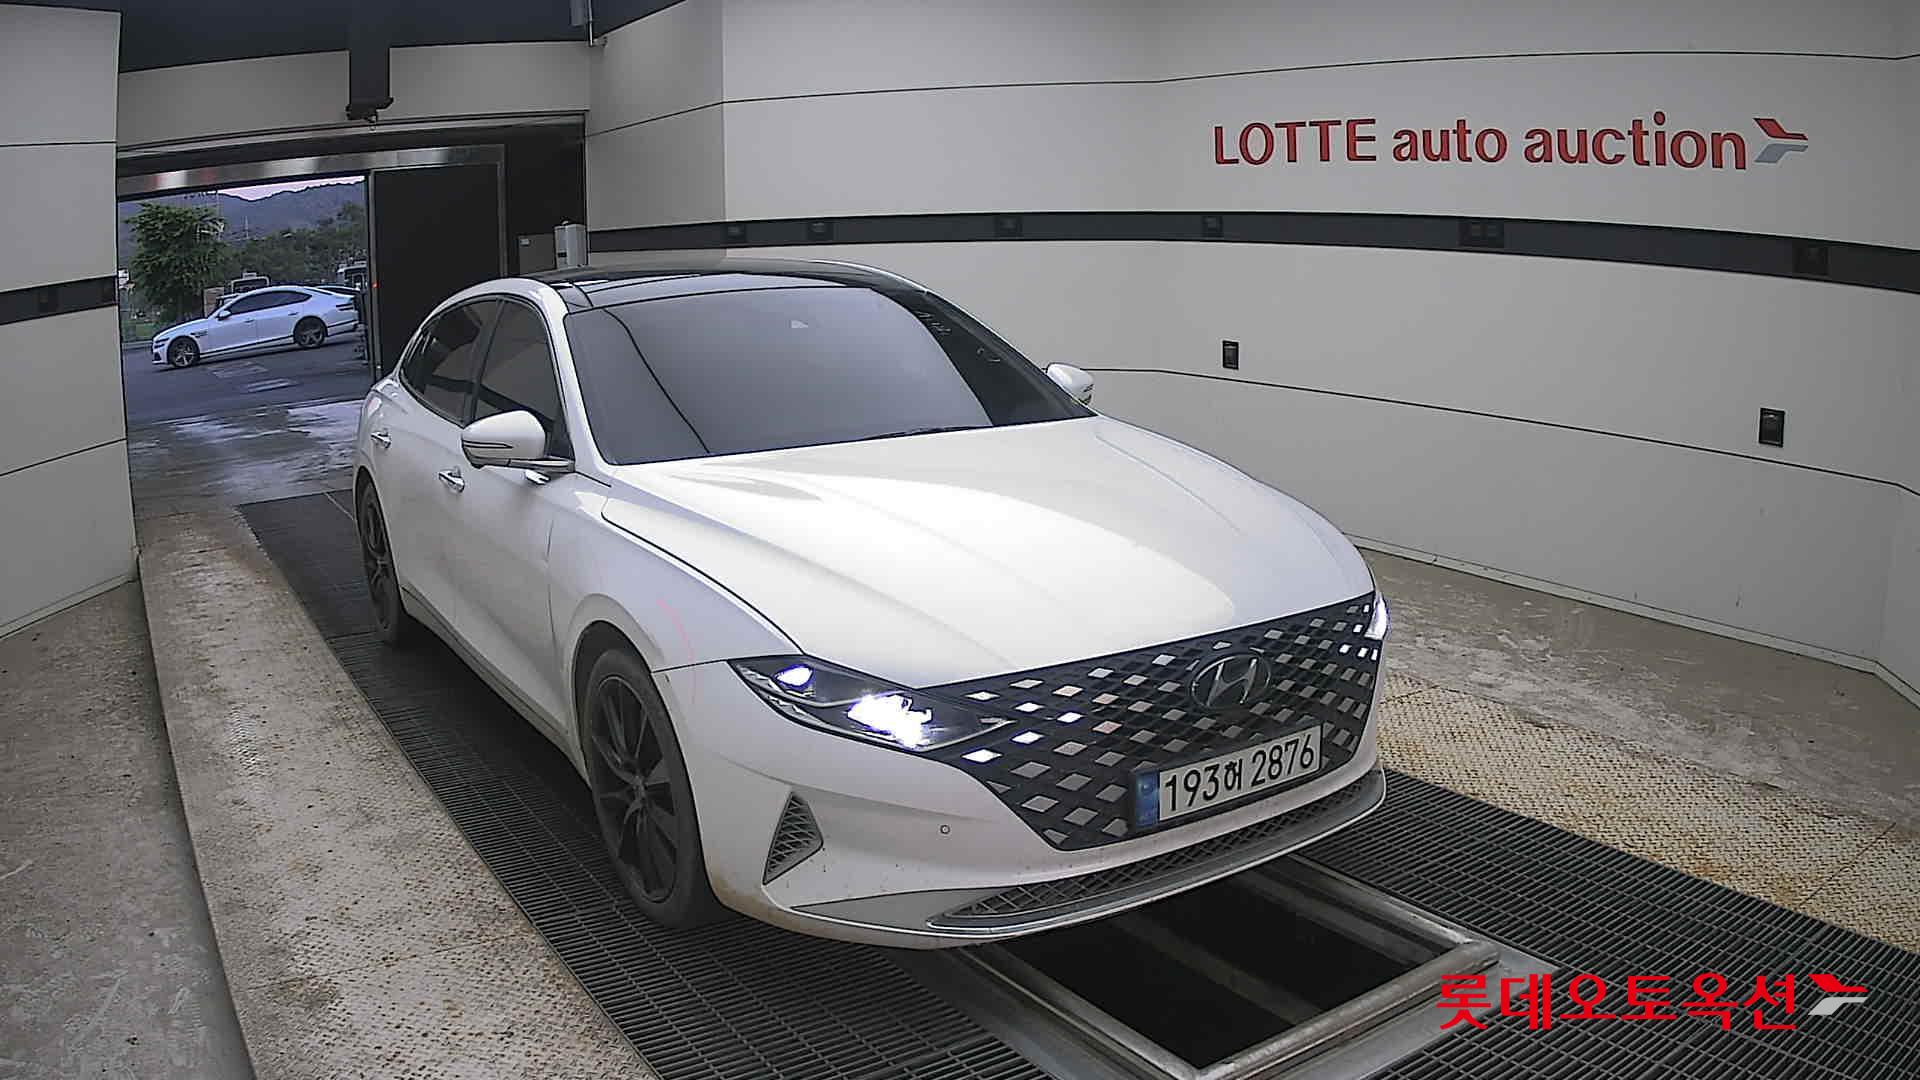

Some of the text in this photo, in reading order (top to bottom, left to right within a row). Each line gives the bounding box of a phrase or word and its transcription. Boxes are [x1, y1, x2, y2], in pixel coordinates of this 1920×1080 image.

[1213, 111, 1748, 171] LOTTE auto auction
[1164, 733, 1315, 812] 193허 2876
